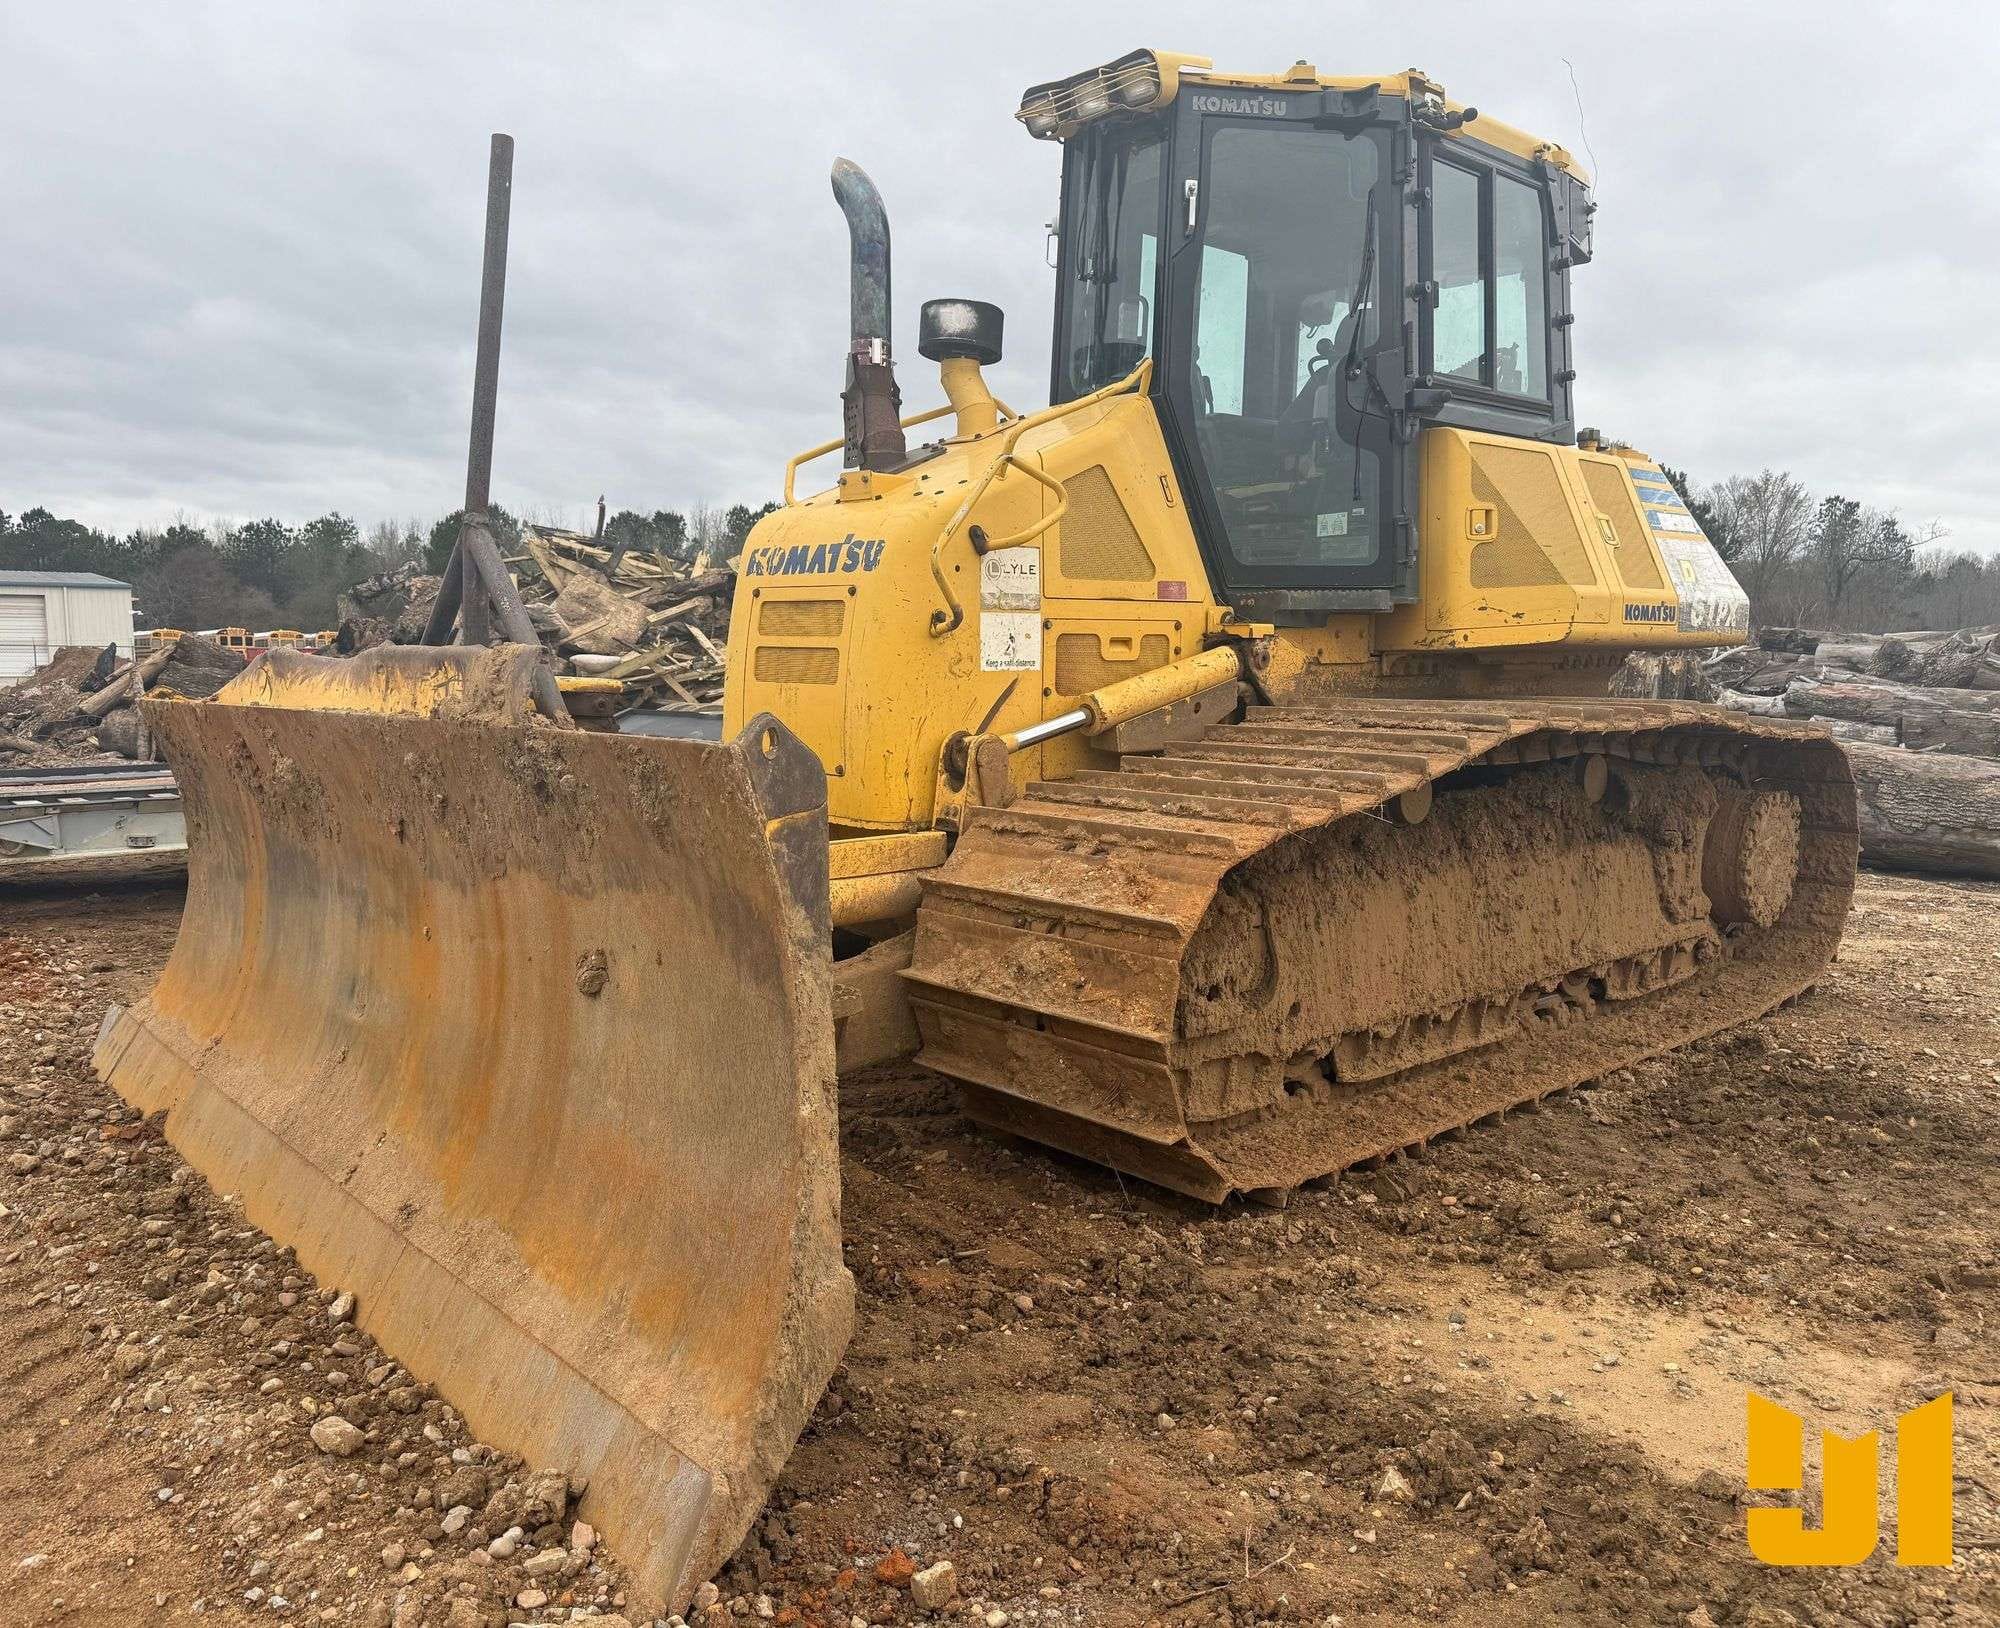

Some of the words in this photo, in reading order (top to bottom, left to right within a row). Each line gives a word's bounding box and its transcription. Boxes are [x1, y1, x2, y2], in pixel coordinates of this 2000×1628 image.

[1192, 95, 1287, 116] KOMATSU
[746, 533, 886, 576] KOMATSU
[1003, 564, 1037, 575] LYLE
[1624, 601, 1676, 622] KOMATSU
